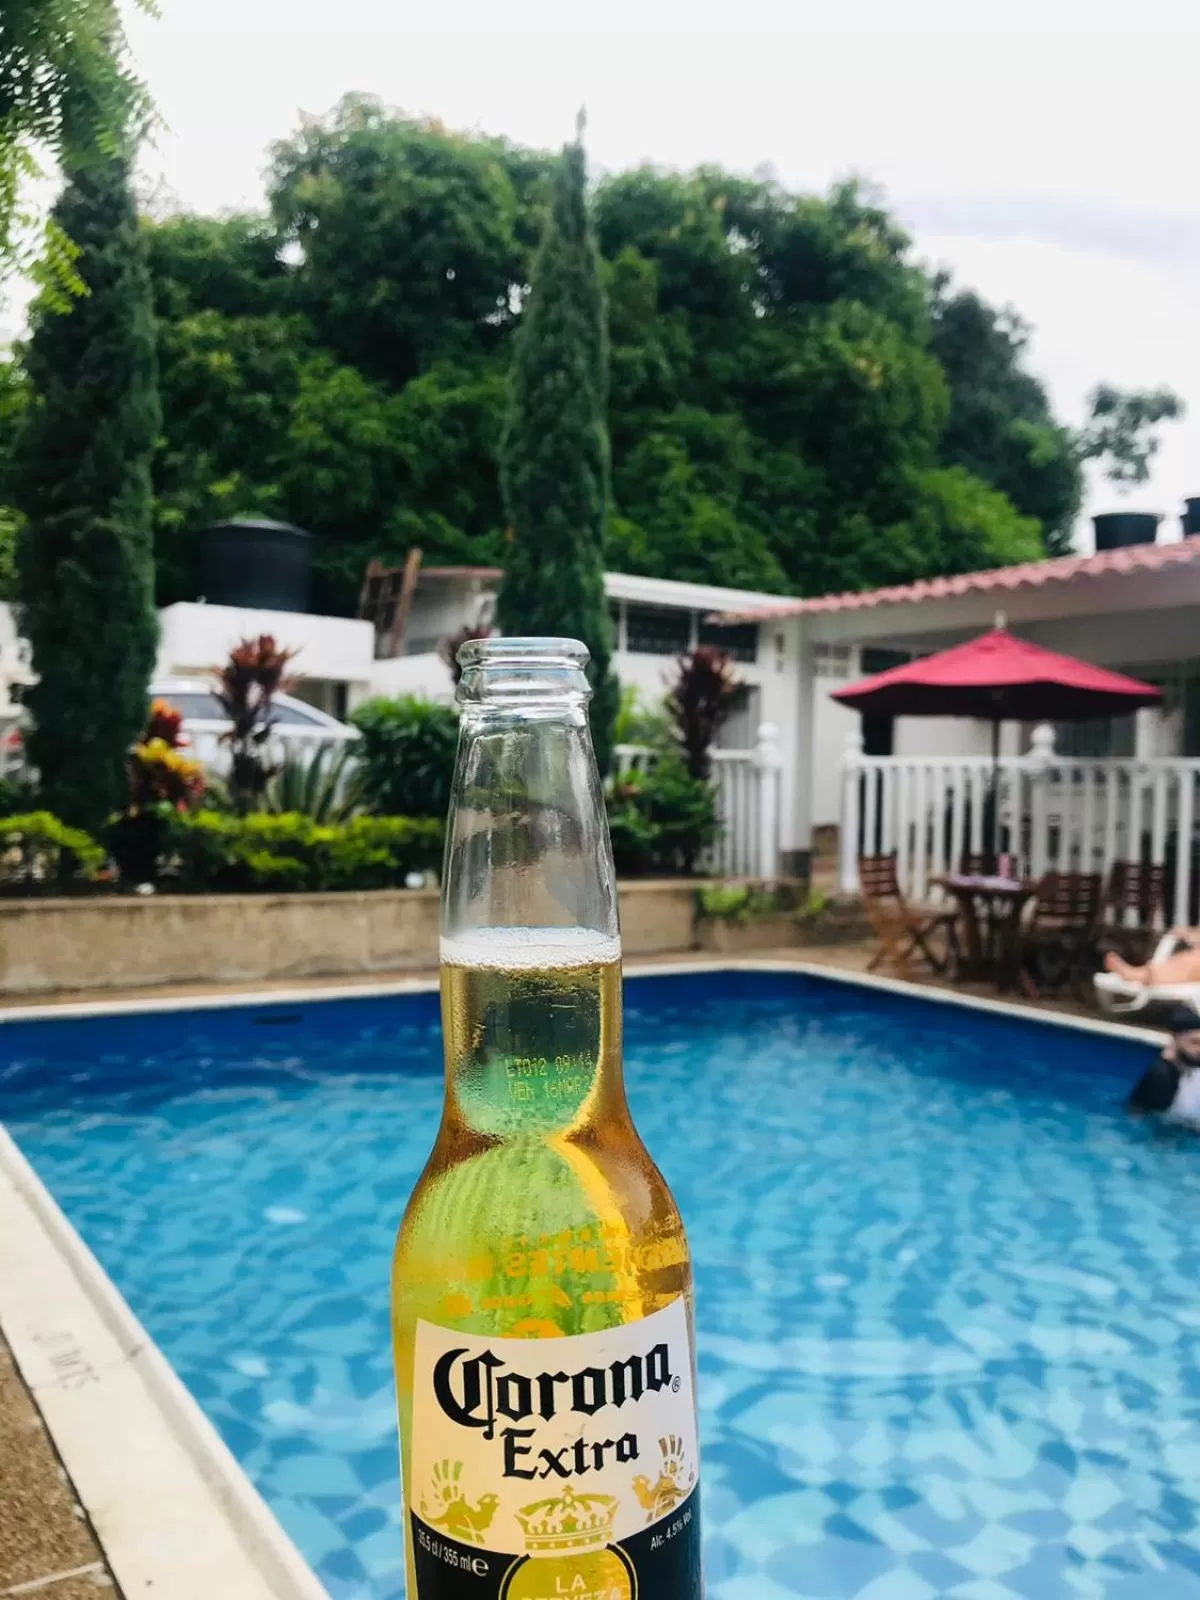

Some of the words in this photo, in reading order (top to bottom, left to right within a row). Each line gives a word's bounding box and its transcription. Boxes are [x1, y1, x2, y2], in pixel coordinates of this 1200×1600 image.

[433, 1343, 673, 1440] Corona
[500, 1427, 640, 1480] Extra
[443, 1546, 459, 1567] 355
[555, 1572, 587, 1593] LA
